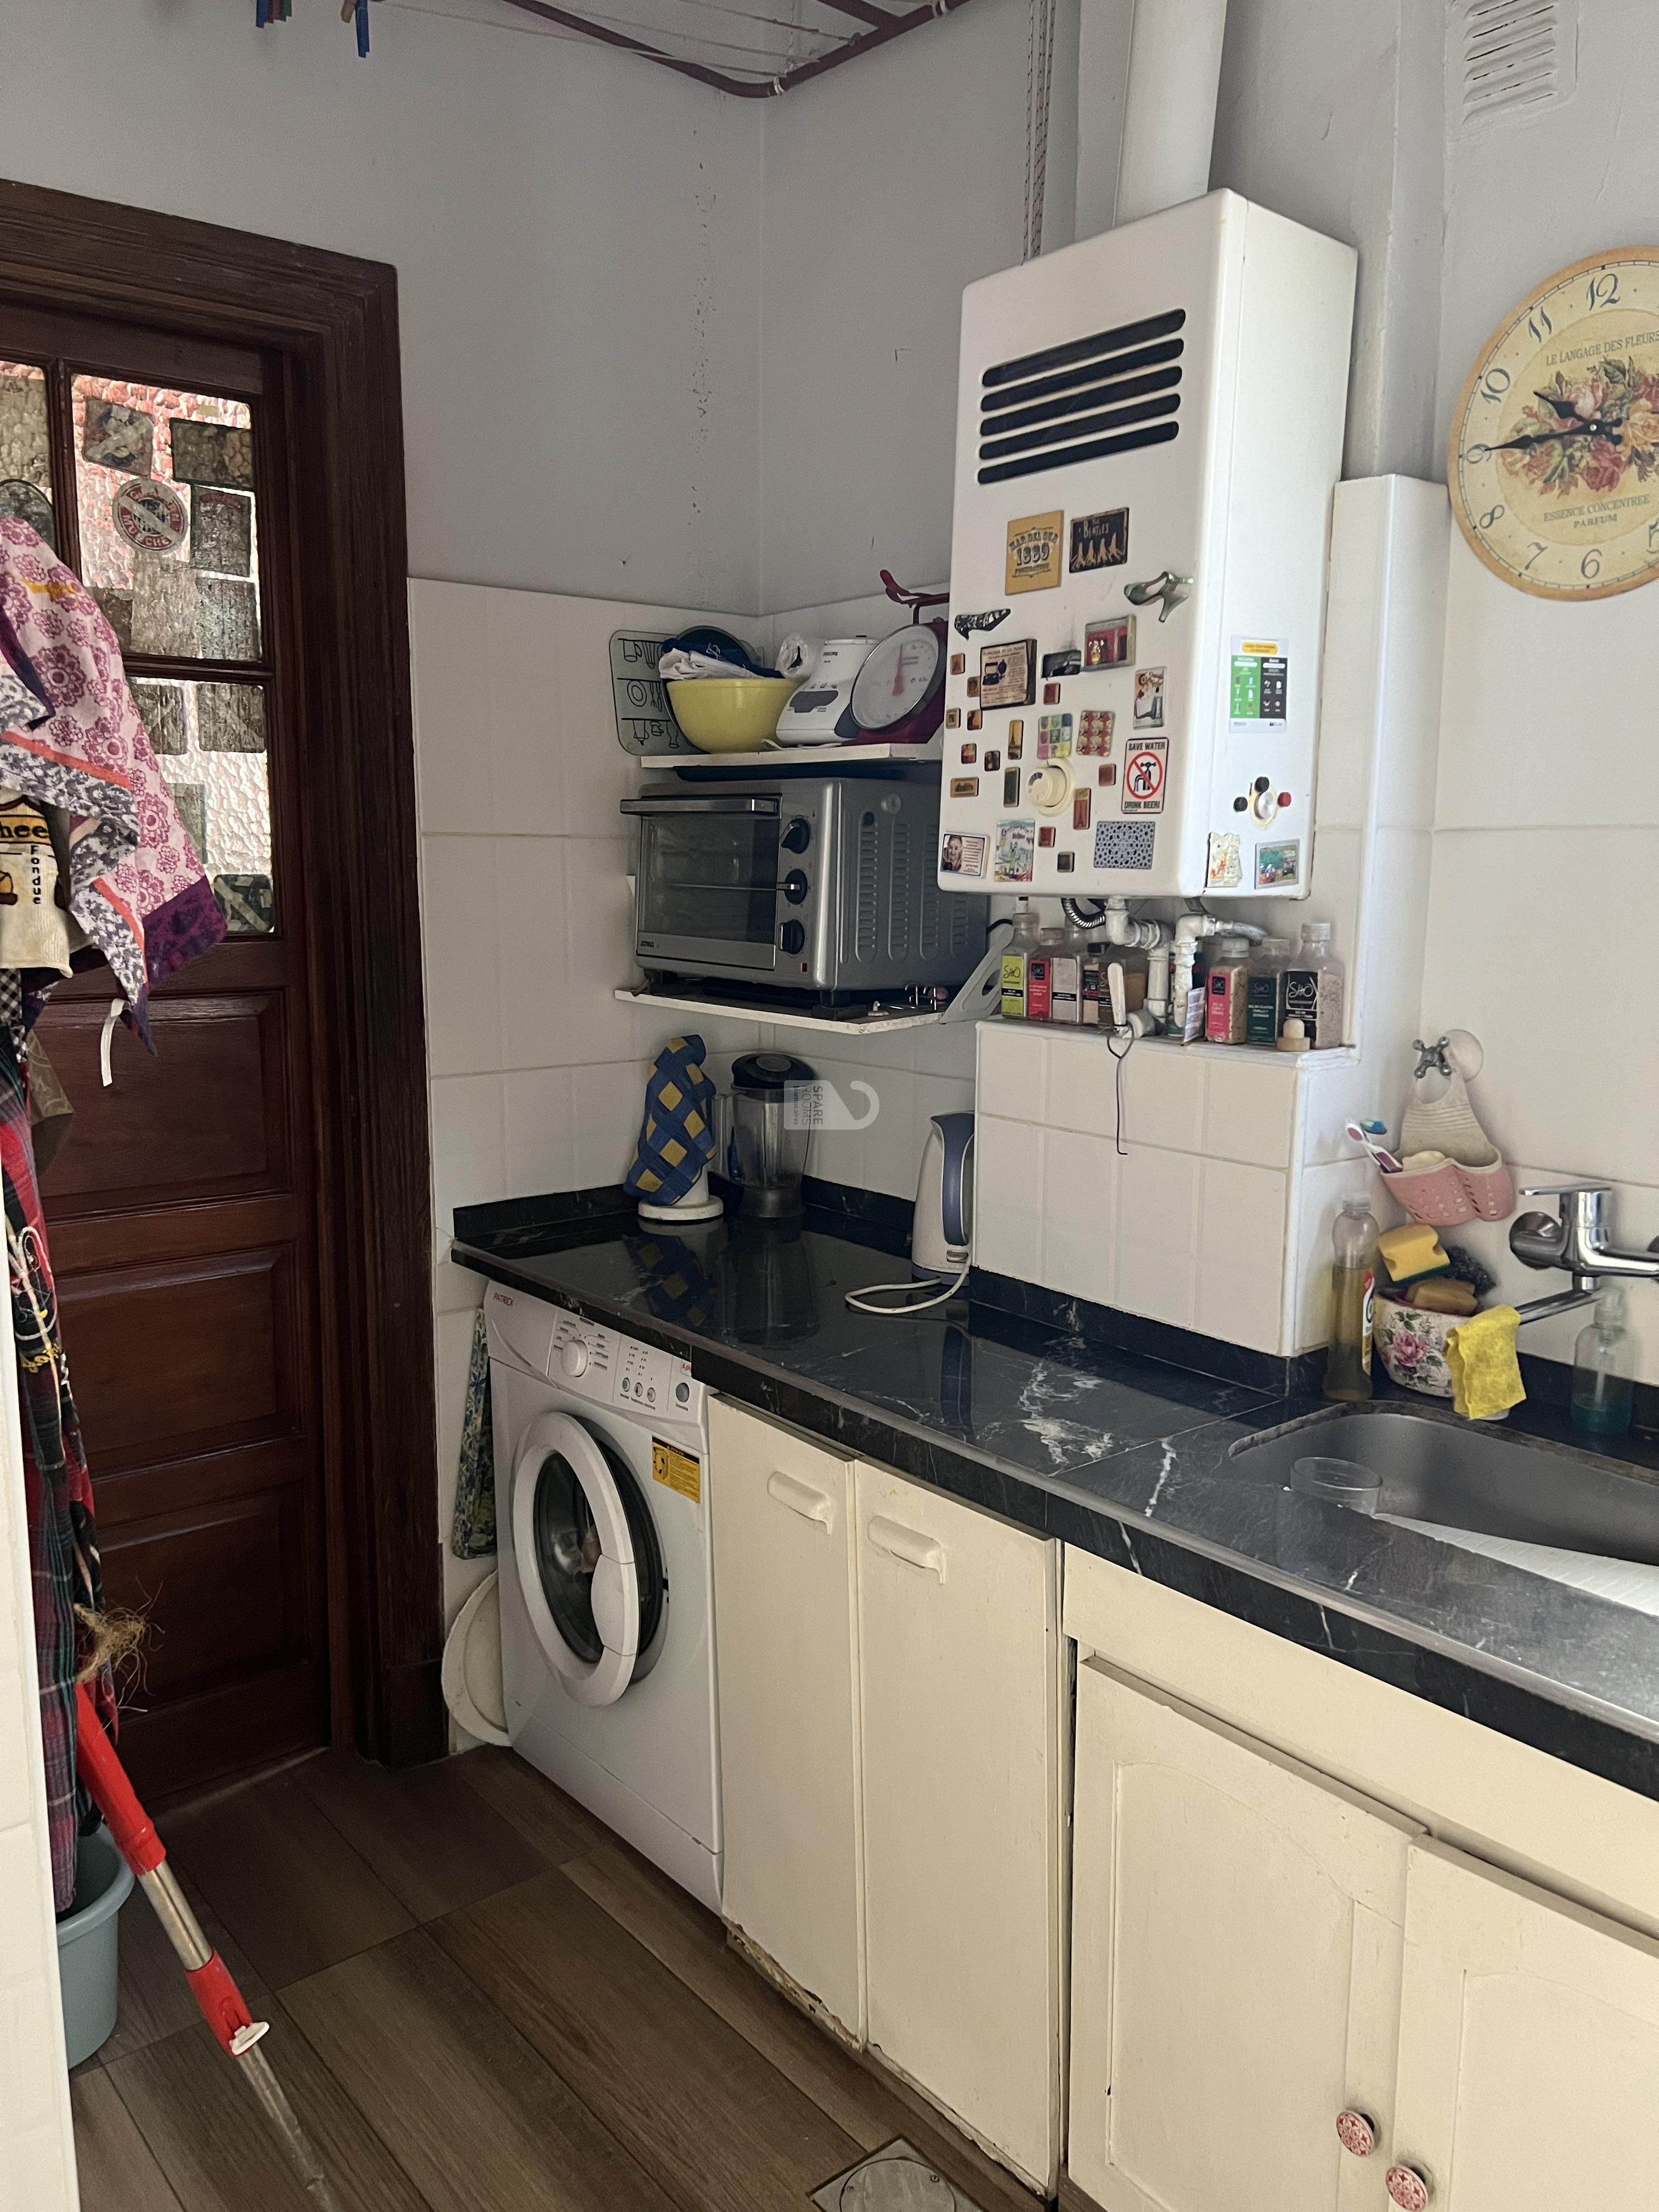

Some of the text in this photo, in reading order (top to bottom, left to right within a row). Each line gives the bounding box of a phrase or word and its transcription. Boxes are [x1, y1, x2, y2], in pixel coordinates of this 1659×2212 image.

[1587, 274, 1620, 311] 12
[1528, 306, 1552, 343] 11
[1546, 355, 1558, 366] LE
[1560, 343, 1601, 363] LANGAGE
[1604, 338, 1623, 353] DES
[1481, 368, 1510, 404] 10
[1480, 504, 1505, 529] 8
[1544, 494, 1650, 522] ESSENCE CONCENTREE
[1573, 514, 1618, 528] PARFUM
[1525, 542, 1548, 571] 7
[1581, 549, 1602, 579] 6
[1145, 742, 1165, 750] WATER
